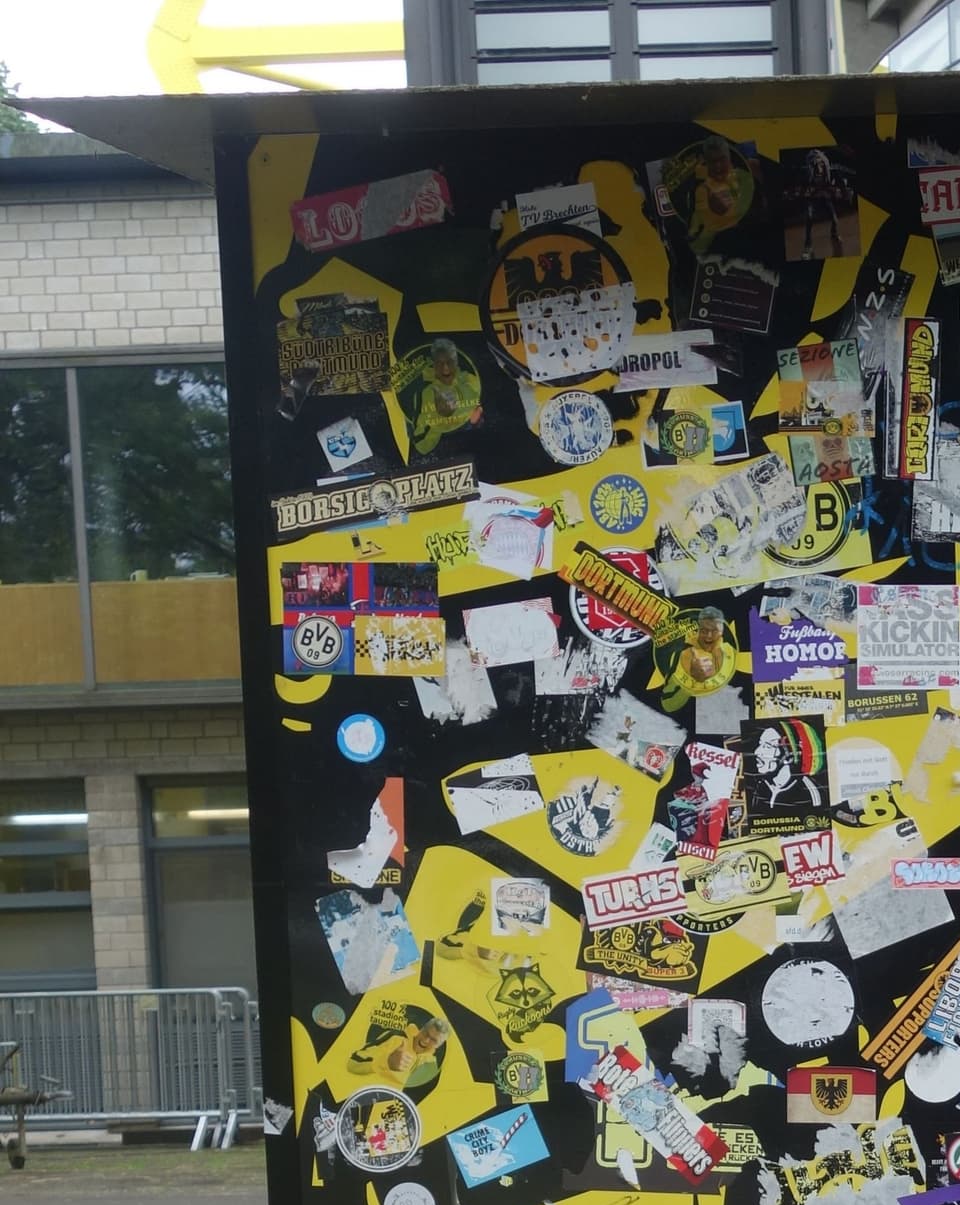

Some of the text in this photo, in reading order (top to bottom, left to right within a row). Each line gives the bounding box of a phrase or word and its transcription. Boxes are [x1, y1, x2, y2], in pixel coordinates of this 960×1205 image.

[778, 342, 856, 368] SEZIONE
[799, 454, 872, 484] AOSTA
[392, 463, 474, 505] PLATZ
[573, 551, 675, 628] DORTMUND
[300, 622, 336, 656] BVB
[306, 649, 321, 661] 09
[860, 643, 960, 658] SIMULATOR
[847, 695, 902, 709] BORUSSEN
[904, 692, 918, 702] 62
[753, 816, 801, 826] BORUSSIA
[750, 825, 805, 835] DORTMUND
[613, 928, 635, 945] BVB
[597, 949, 645, 966] THE UNITY
[381, 1000, 397, 1011] 100
[464, 1126, 490, 1143] CRIME
[471, 1138, 489, 1150] CITY
[471, 1142, 494, 1158] BOYZ
